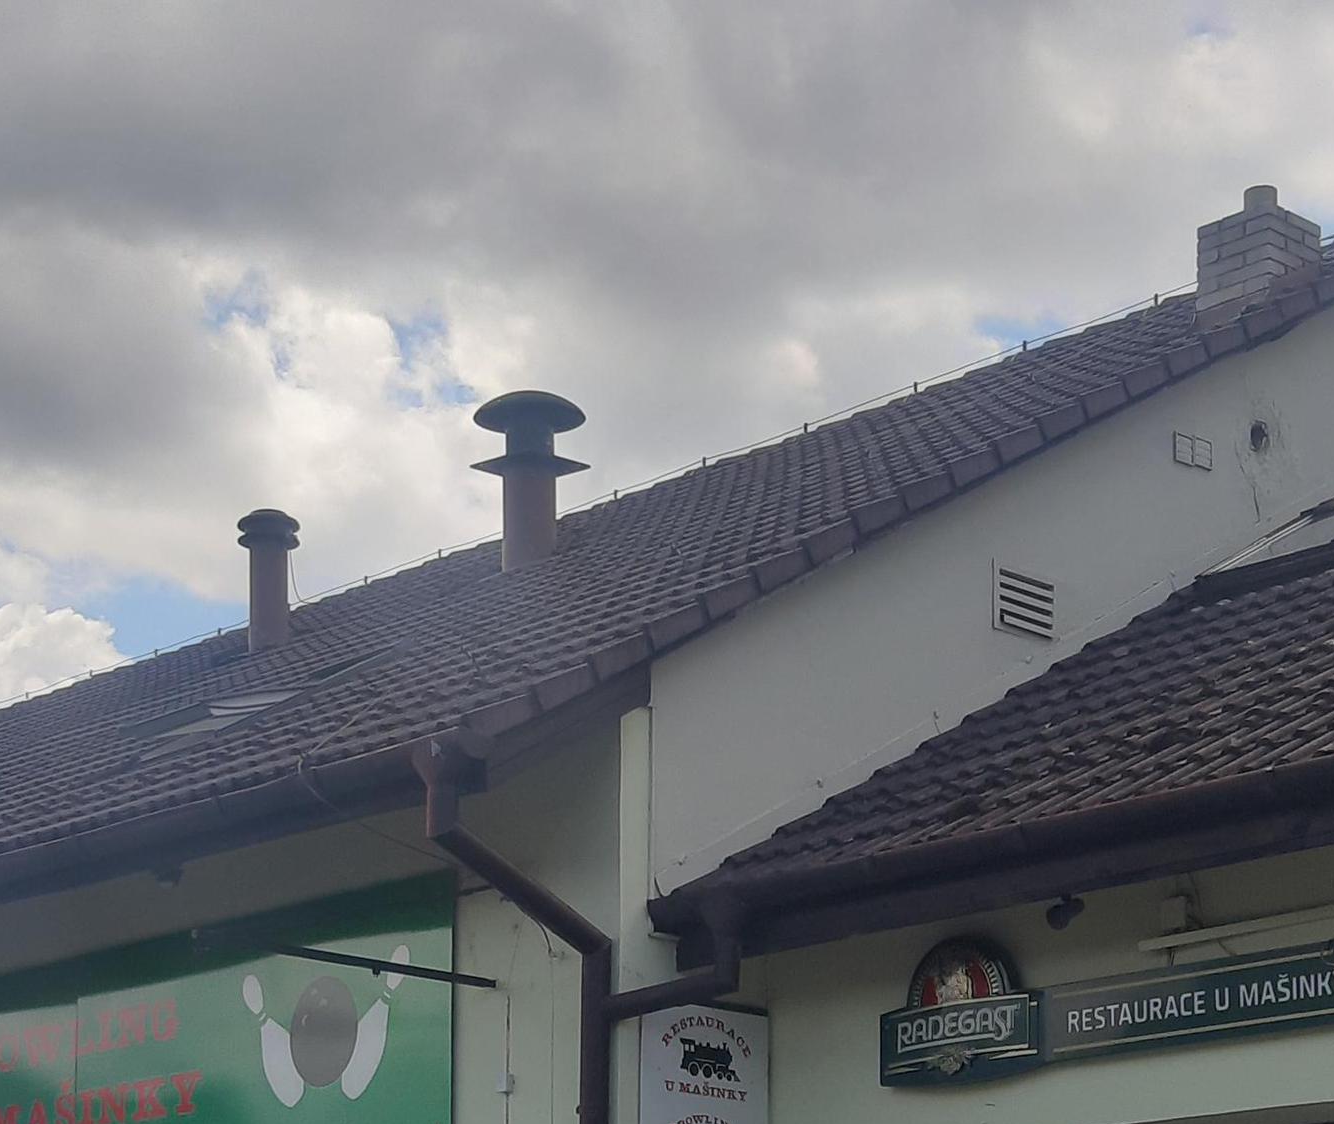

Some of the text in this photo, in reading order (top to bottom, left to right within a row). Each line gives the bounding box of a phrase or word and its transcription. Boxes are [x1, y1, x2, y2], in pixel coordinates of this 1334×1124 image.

[897, 1002, 1019, 1053] RADEGAST
[1067, 990, 1206, 1033] RESTAURACE
[1214, 989, 1230, 1012] U
[661, 1016, 752, 1057] RESTAURACE
[665, 1080, 747, 1102] U MAŠINKY
